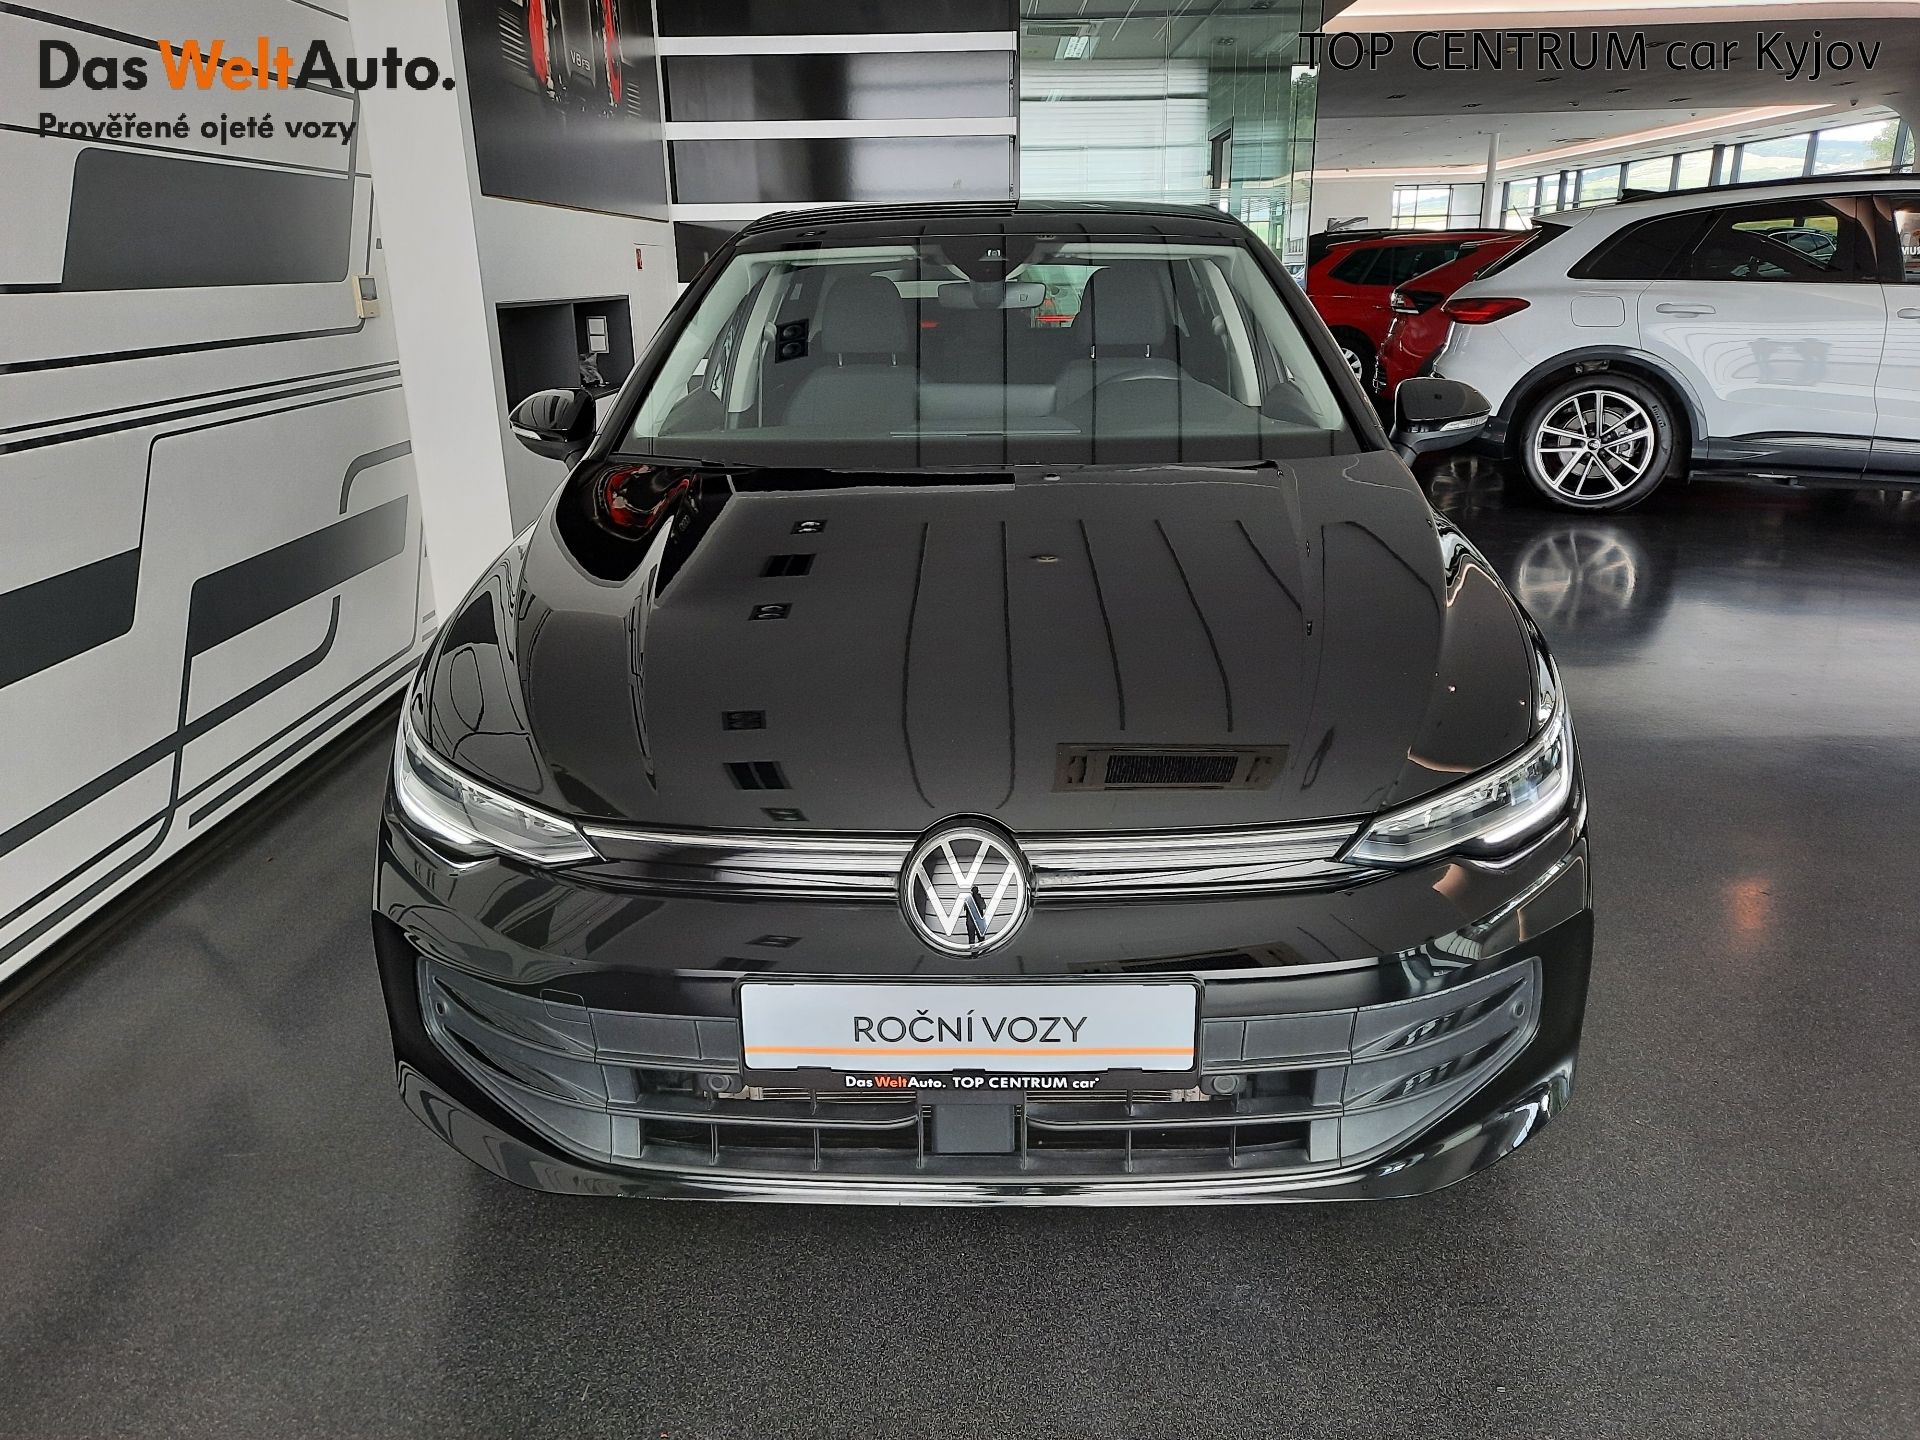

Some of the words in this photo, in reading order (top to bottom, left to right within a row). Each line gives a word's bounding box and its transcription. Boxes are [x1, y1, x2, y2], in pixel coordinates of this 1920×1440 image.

[853, 1009, 976, 1043] ROČNÍ
[980, 1015, 1089, 1043] VOZY
[844, 1075, 874, 1088] Das
[952, 1076, 985, 1089] TOP
[988, 1076, 1068, 1089] CENTRUM
